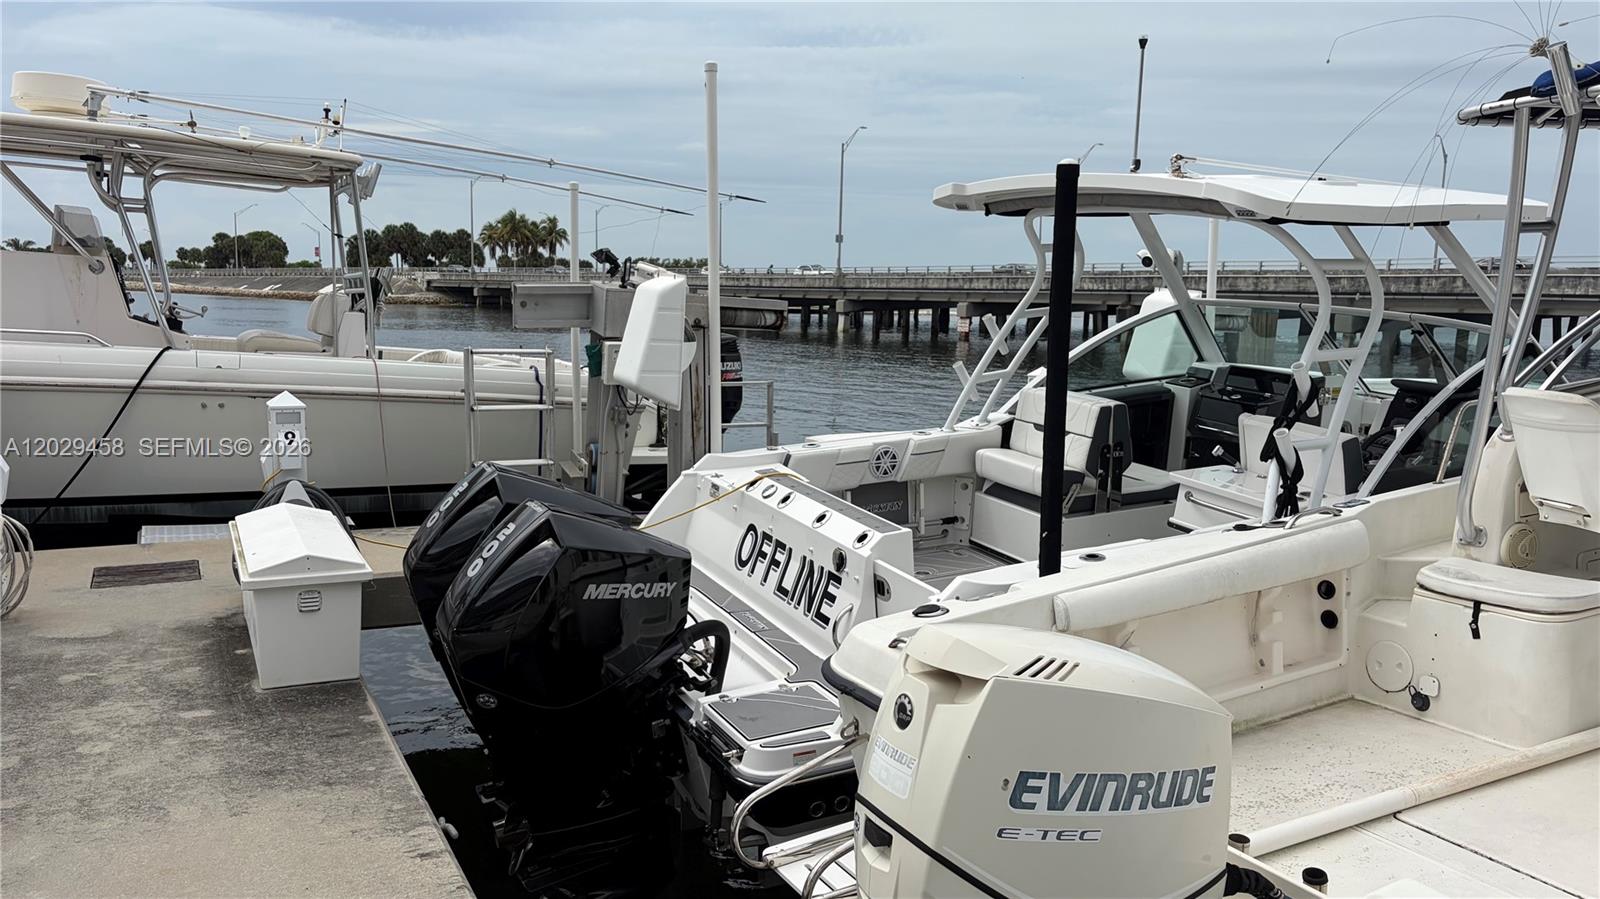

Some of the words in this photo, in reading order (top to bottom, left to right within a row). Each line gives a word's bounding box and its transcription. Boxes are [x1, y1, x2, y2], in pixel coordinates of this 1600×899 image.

[284, 430, 296, 446] 9
[426, 481, 469, 528] 200
[466, 521, 517, 578] 200
[582, 582, 677, 600] MERCURY
[734, 523, 842, 631] OFFLINE
[1008, 765, 1217, 812] EVINRUDE
[996, 828, 1102, 841] E-TEC
